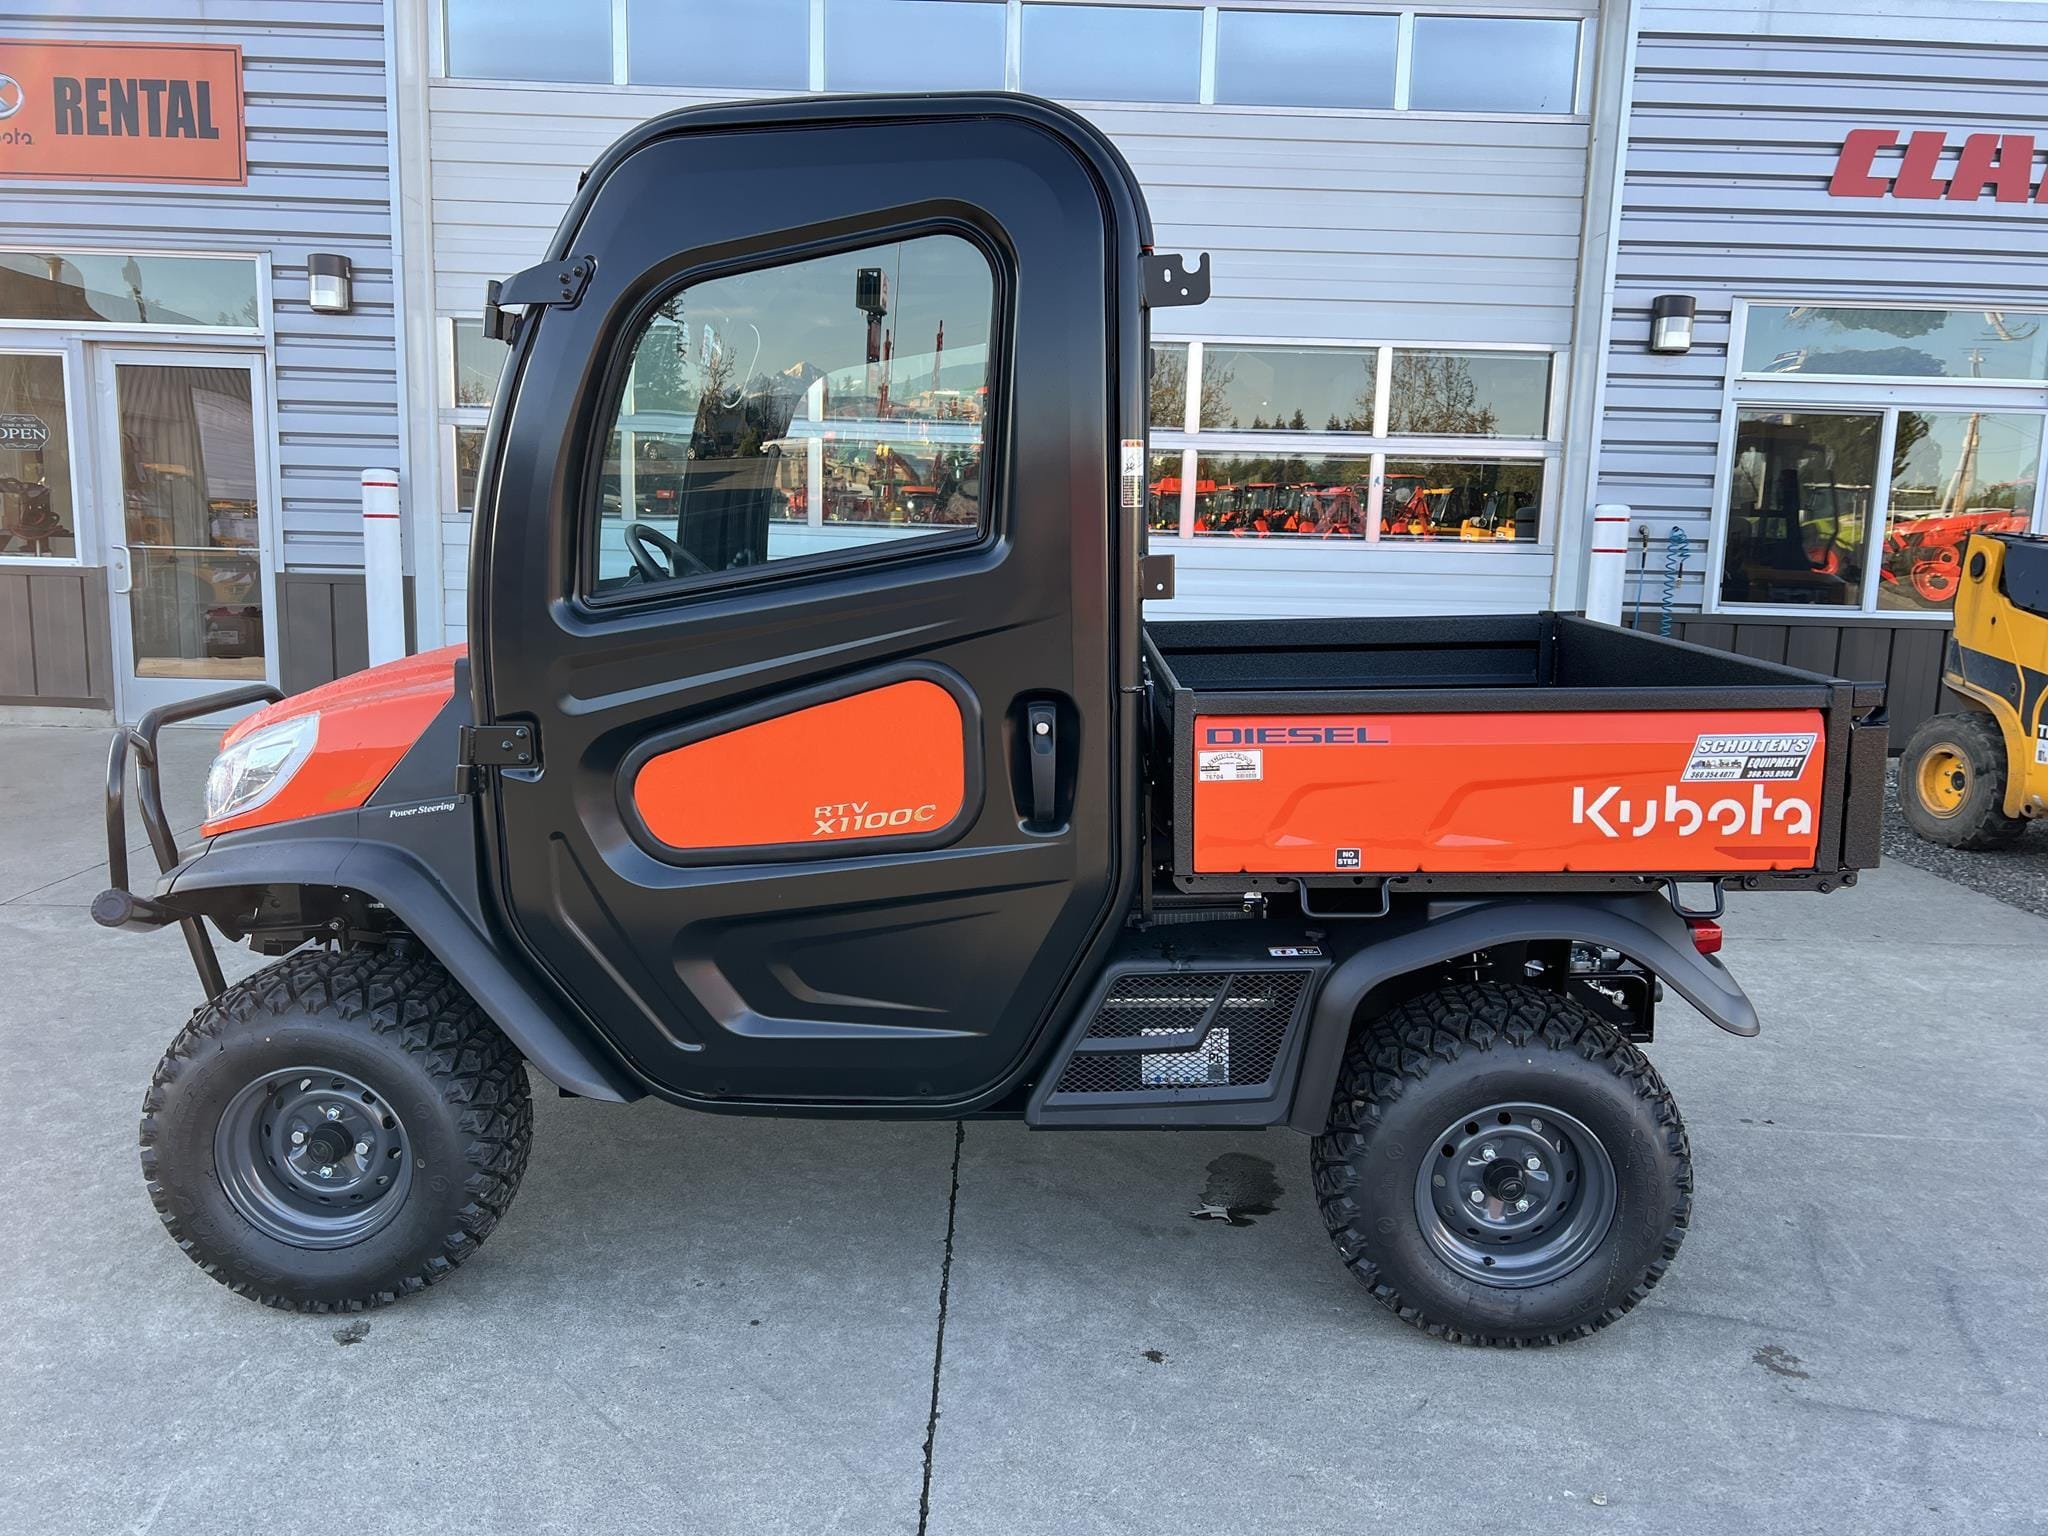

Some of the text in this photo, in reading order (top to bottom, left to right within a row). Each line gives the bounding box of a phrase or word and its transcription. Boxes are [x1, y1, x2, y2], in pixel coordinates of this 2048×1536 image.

[53, 77, 219, 140] RENTAL
[0, 128, 33, 145] ota
[1828, 128, 2048, 204] CLA
[1207, 728, 1389, 744] DIESEL
[1698, 738, 1809, 754] SCHOLTEN'S
[1746, 757, 1804, 769] EQUIPMENT
[389, 803, 455, 818] Power Steering
[814, 801, 869, 818] RTV
[1572, 783, 1813, 838] Kubota
[812, 804, 937, 836] X1100C
